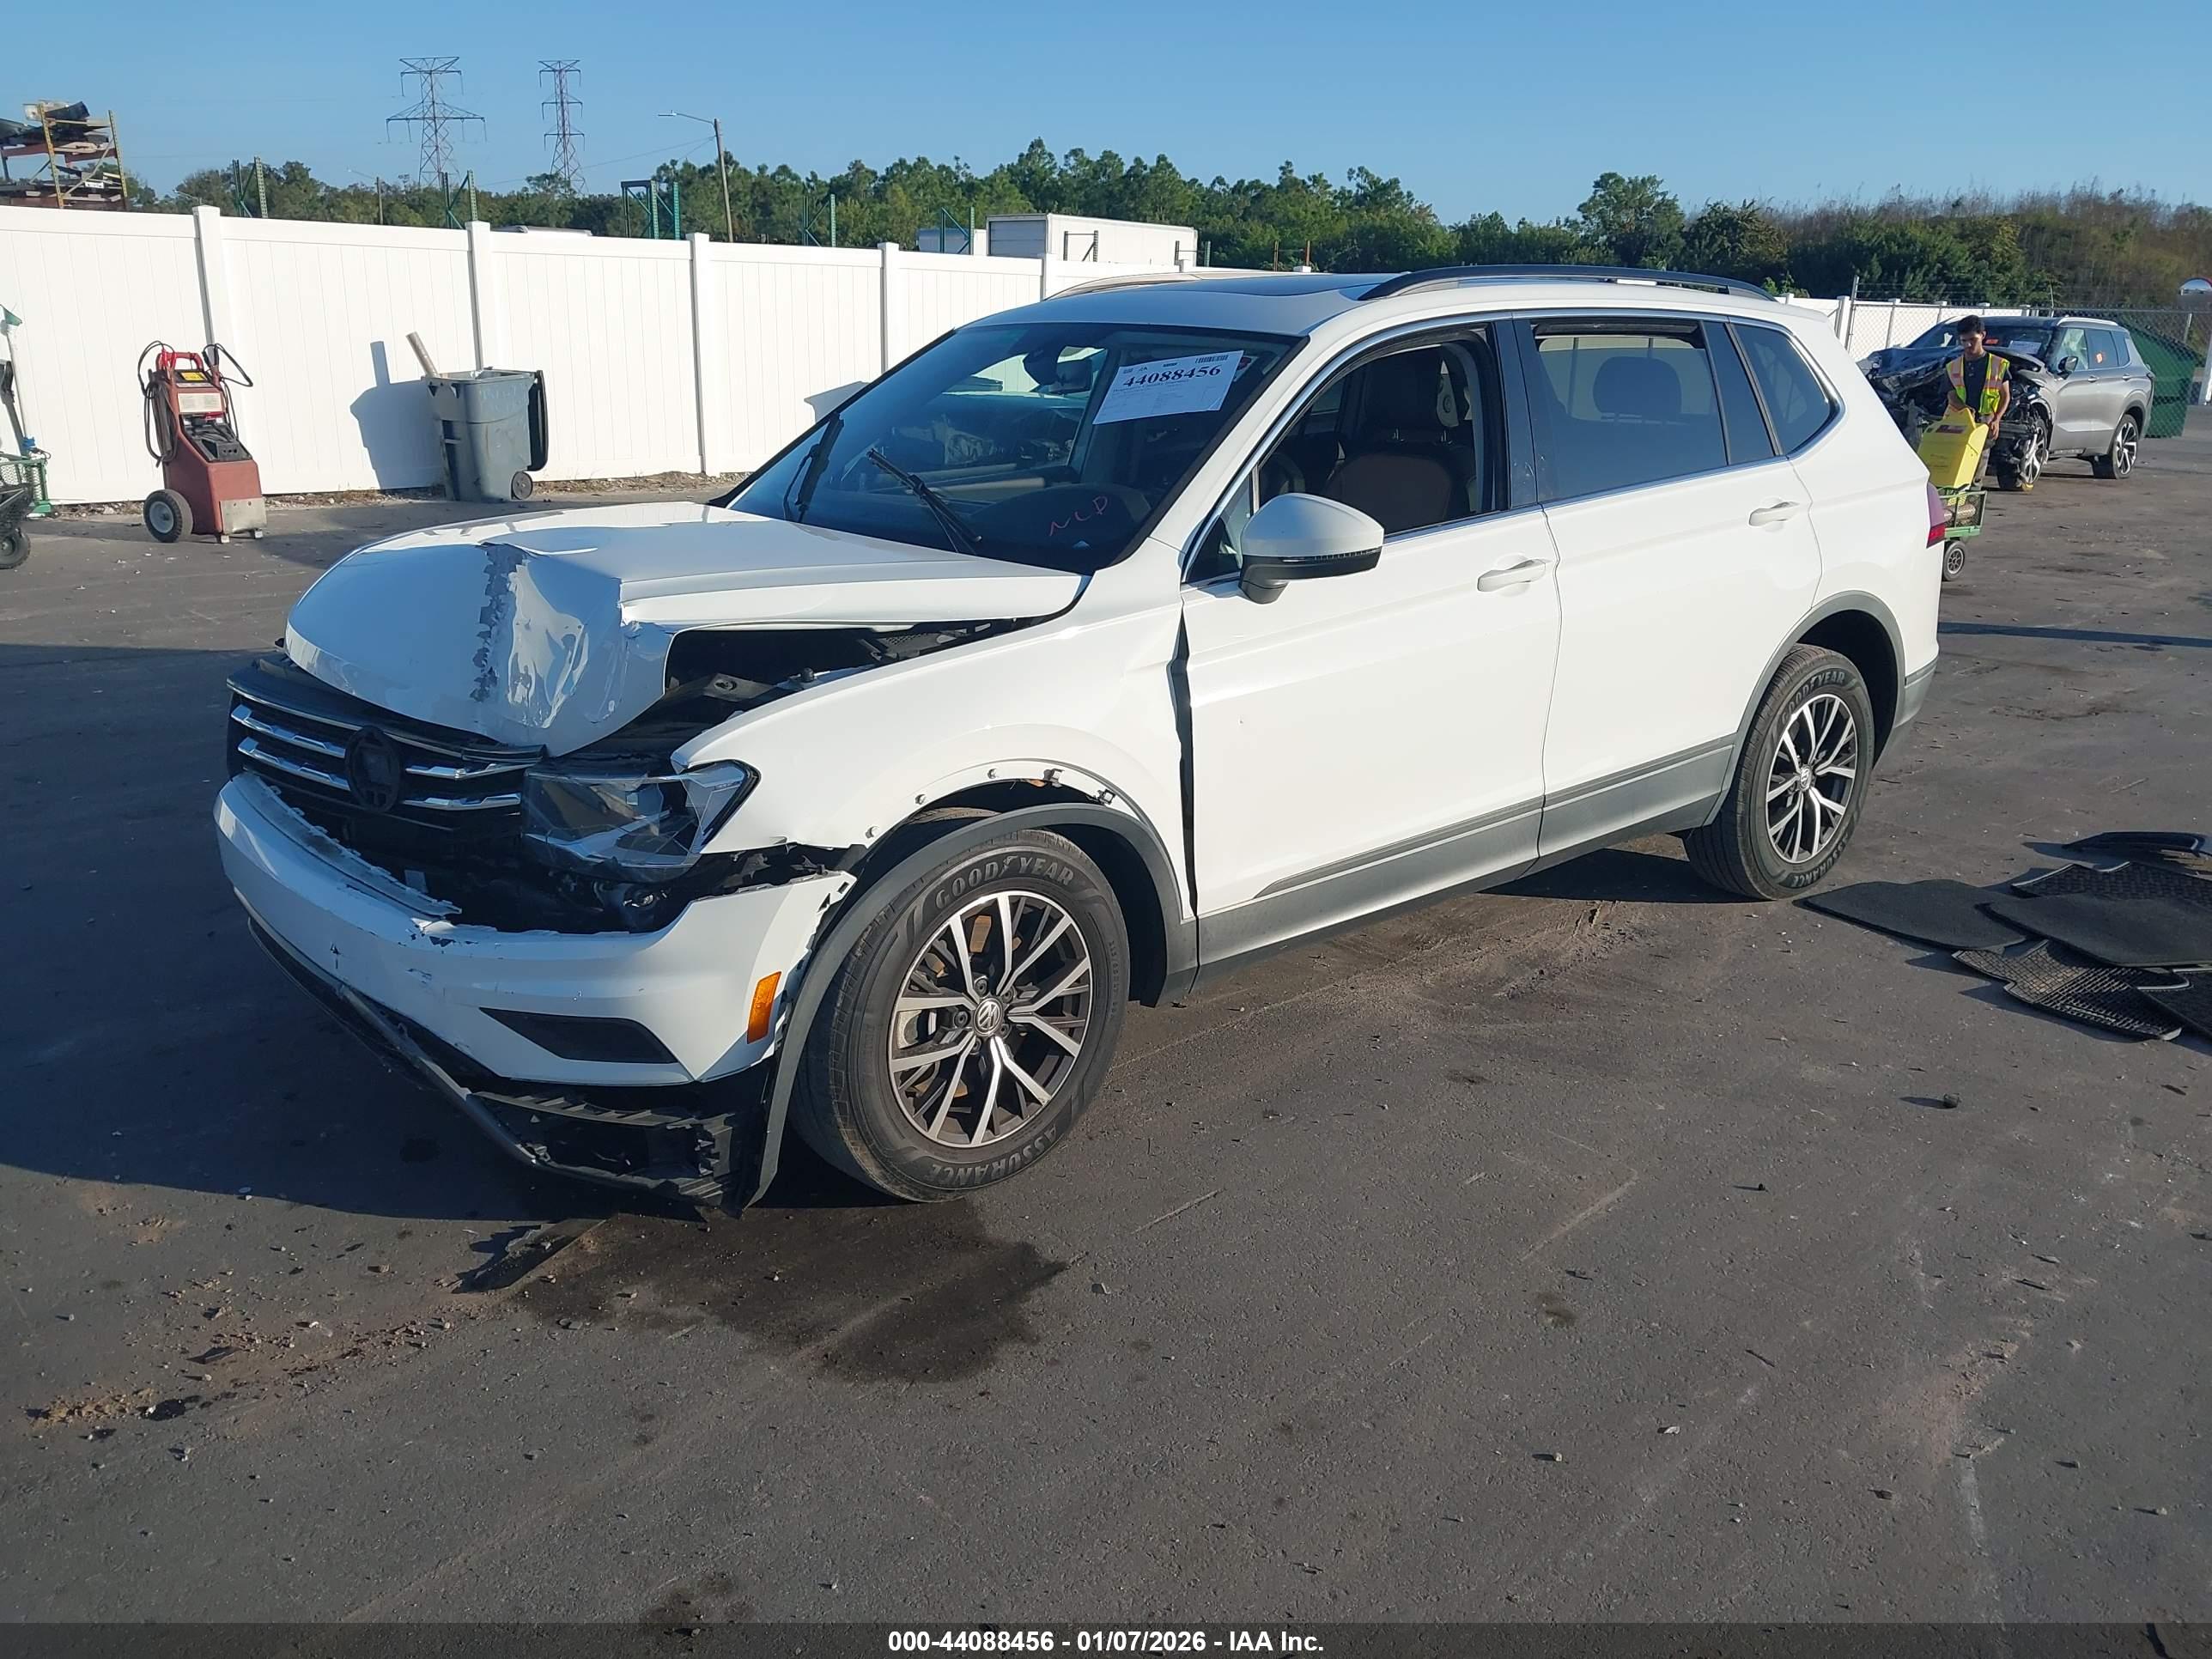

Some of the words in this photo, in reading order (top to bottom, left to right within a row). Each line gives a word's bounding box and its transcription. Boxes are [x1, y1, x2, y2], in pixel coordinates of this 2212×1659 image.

[1123, 365, 1222, 386] 44088456
[935, 855, 1074, 909] GOODYEAR
[927, 1124, 1057, 1186] ASSURANCE
